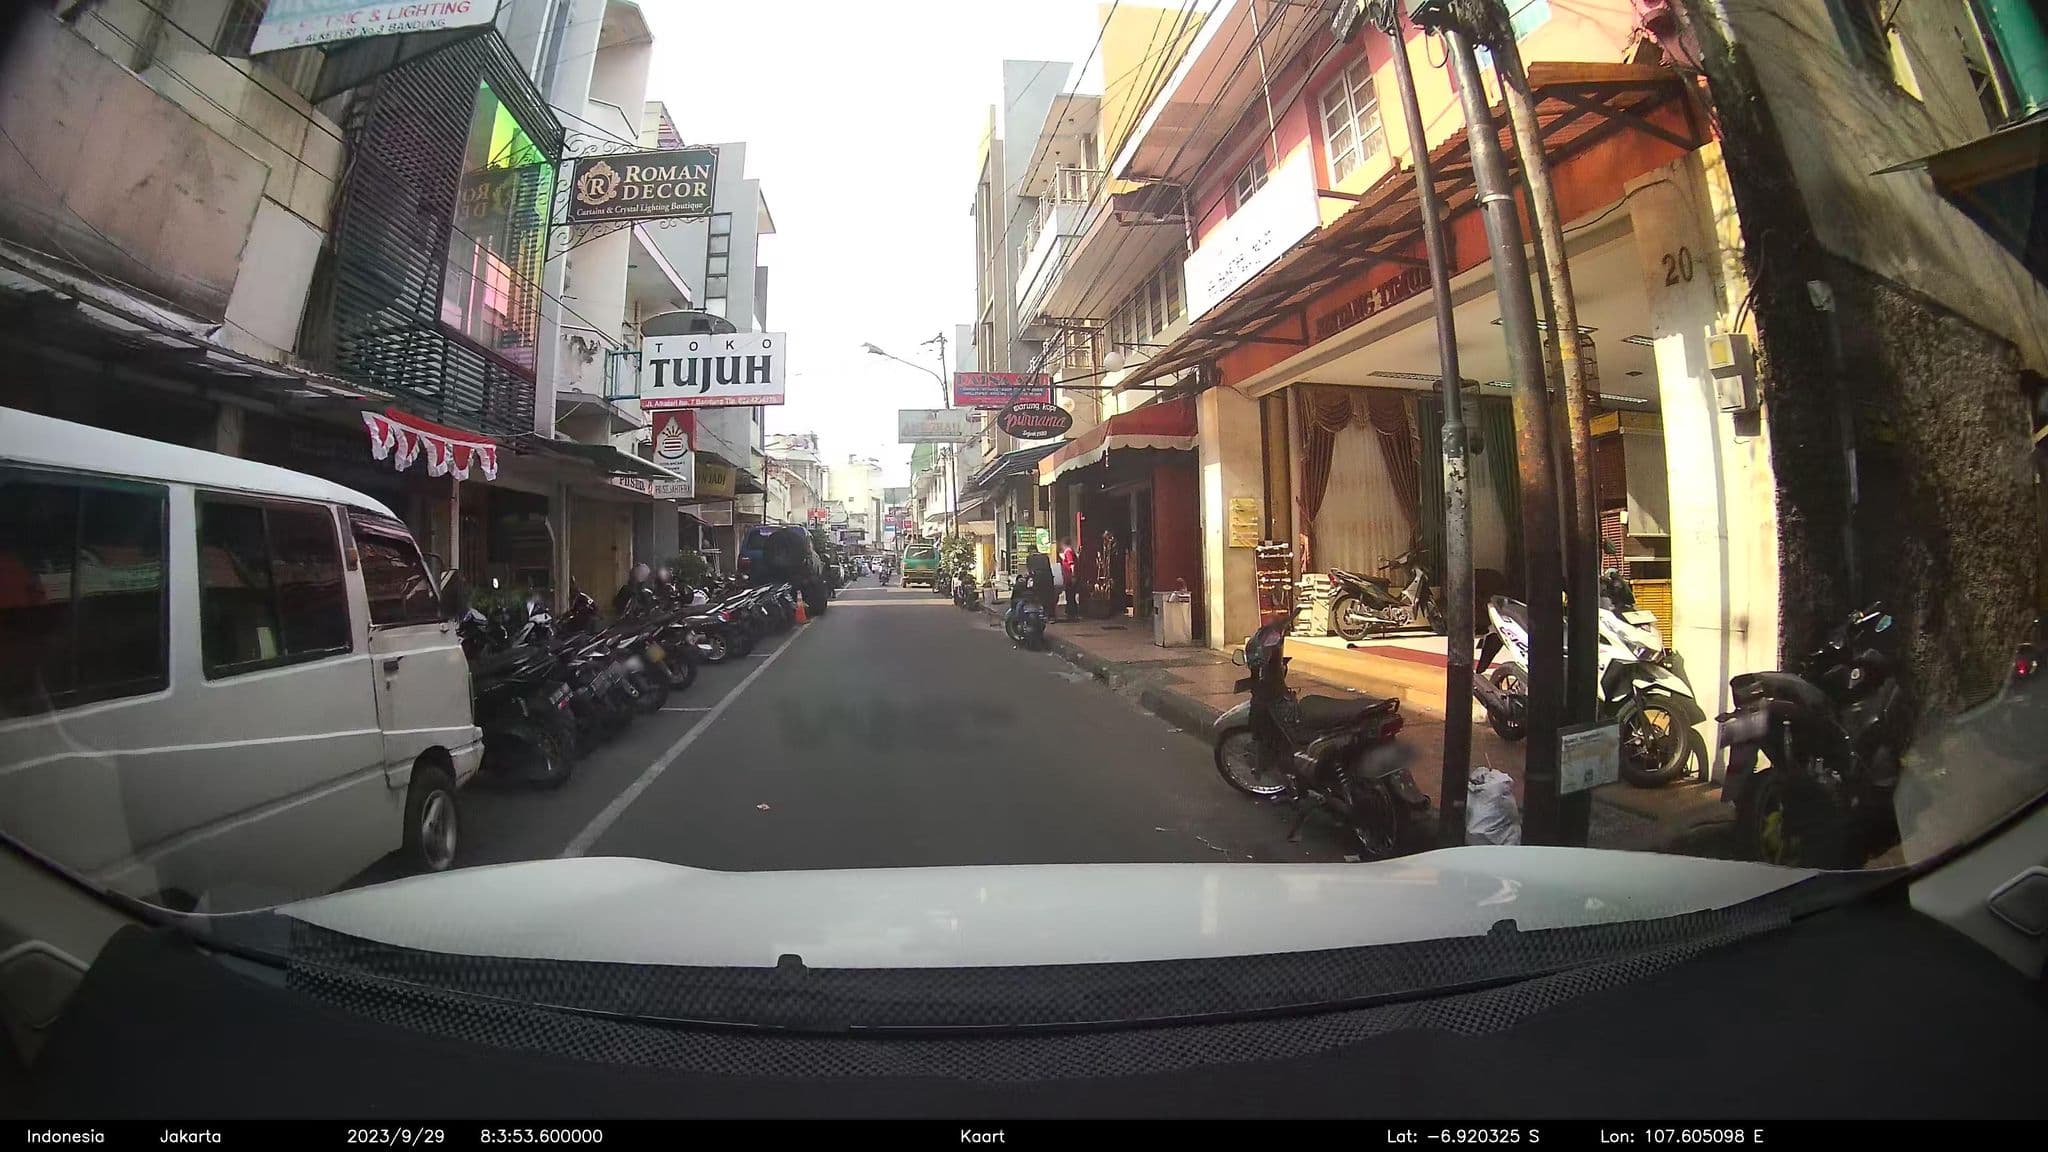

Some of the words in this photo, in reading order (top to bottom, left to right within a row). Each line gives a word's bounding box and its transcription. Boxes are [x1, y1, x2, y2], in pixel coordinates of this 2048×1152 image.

[368, 10, 381, 22] &
[387, 1, 471, 21] LIGHTING
[387, 18, 447, 33] BANDUNG
[623, 164, 712, 183] ROMAN
[621, 182, 709, 201] DECOR
[576, 207, 605, 217] Curtains
[606, 206, 613, 214] &
[614, 203, 639, 215] Crystal
[640, 202, 670, 214] Lighting
[671, 201, 704, 212] Boutique
[1662, 246, 1694, 287] 20
[655, 338, 772, 353] TOKO
[649, 354, 773, 394] TUJUH
[1013, 402, 1040, 413] warung
[1004, 411, 1067, 433] purnama
